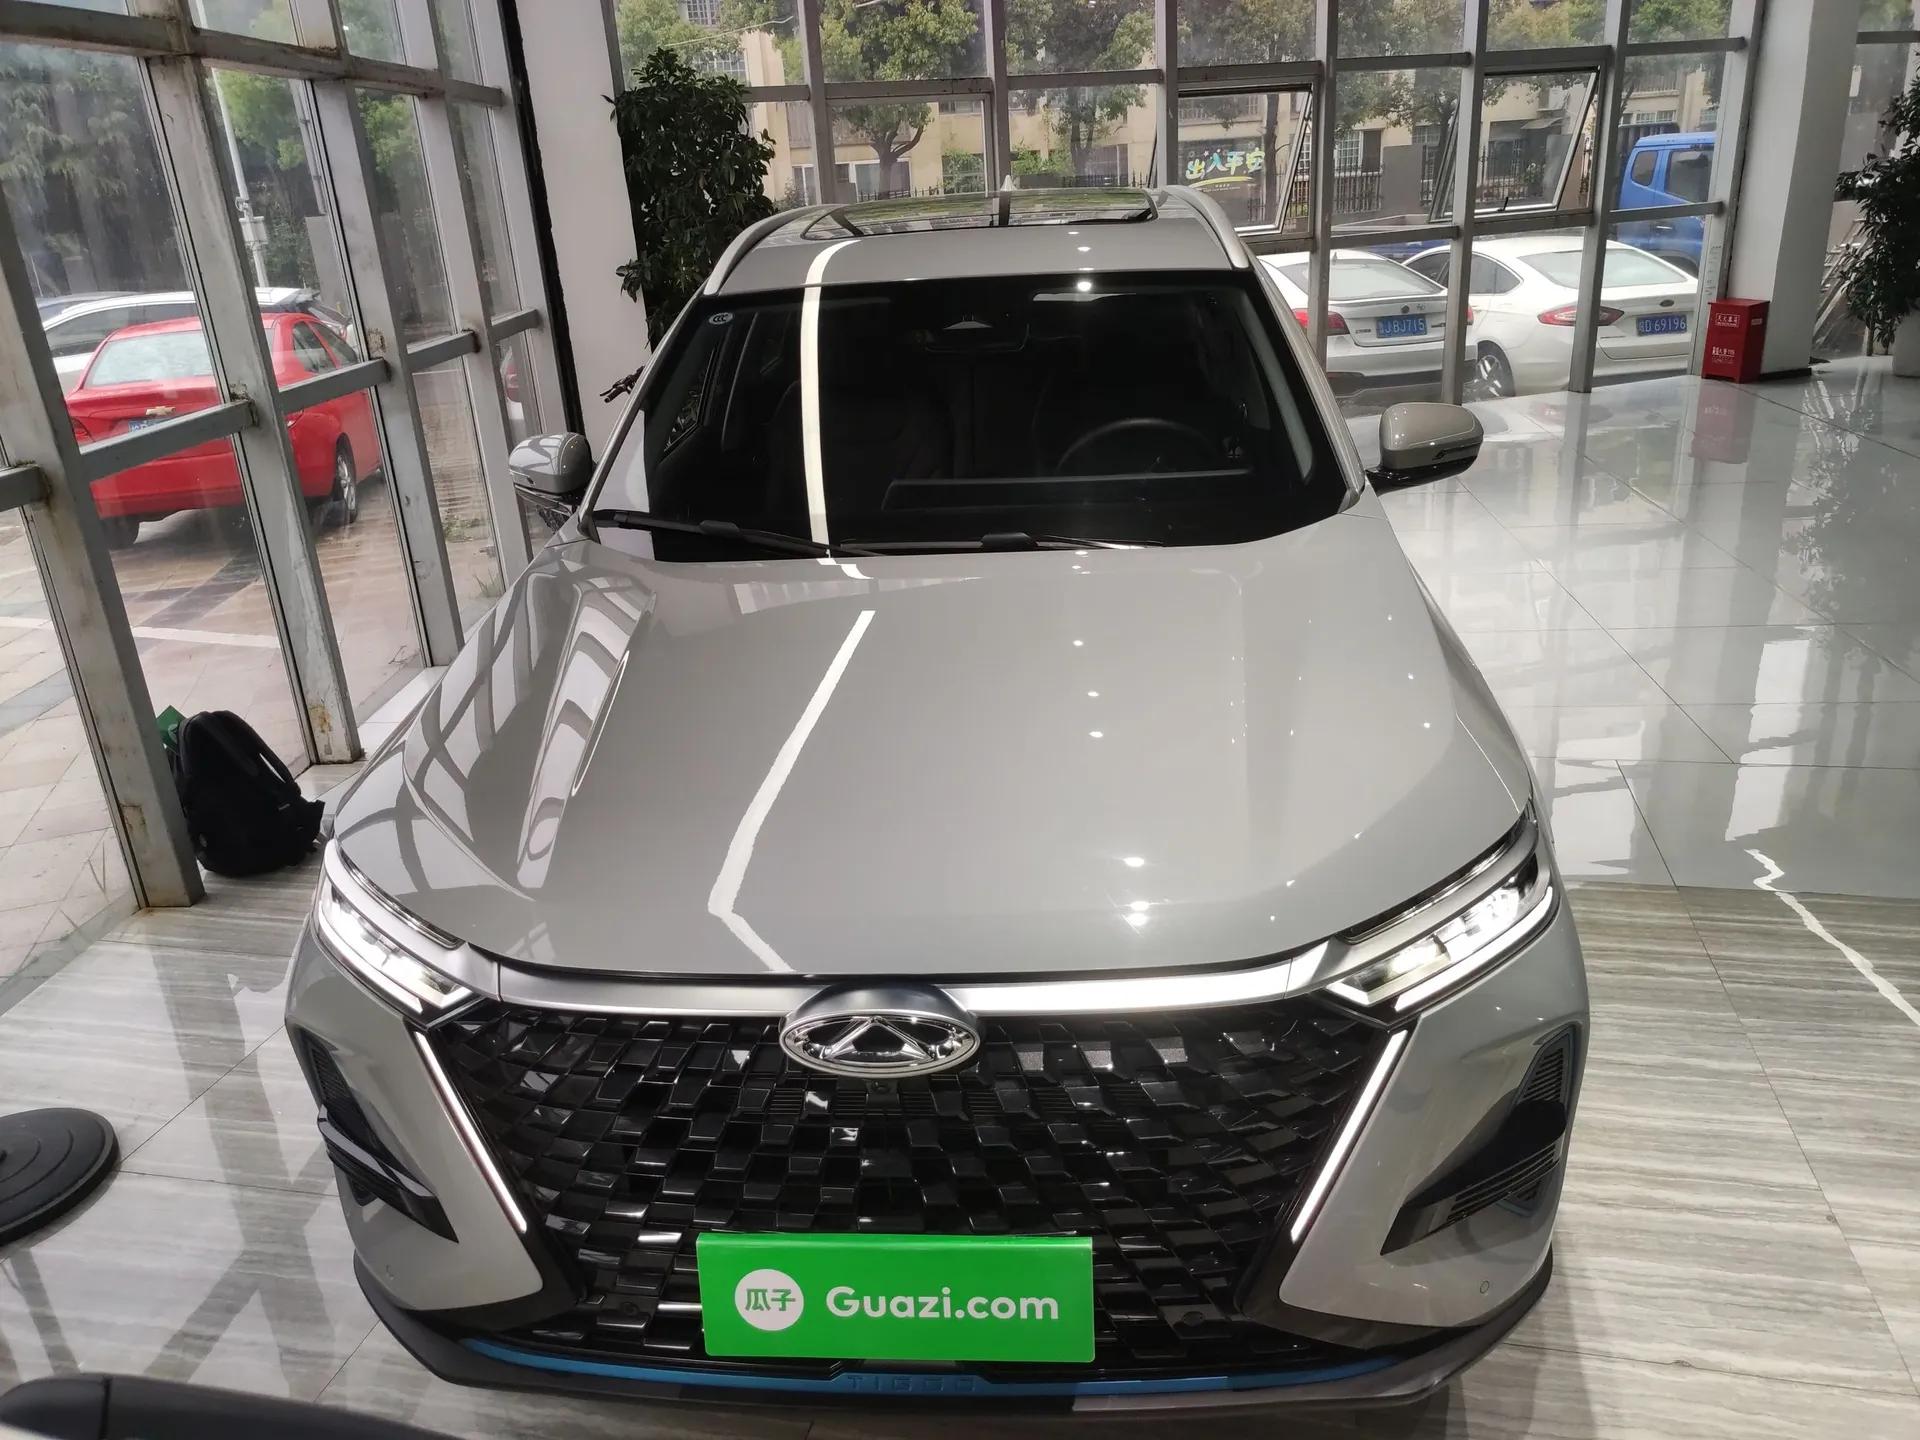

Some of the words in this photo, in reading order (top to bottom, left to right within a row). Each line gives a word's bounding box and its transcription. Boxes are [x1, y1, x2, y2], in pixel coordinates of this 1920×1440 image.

[1185, 147, 1265, 179] 出入平安
[745, 1287, 796, 1312] 瓜子
[826, 1286, 1059, 1320] Guazi.com
